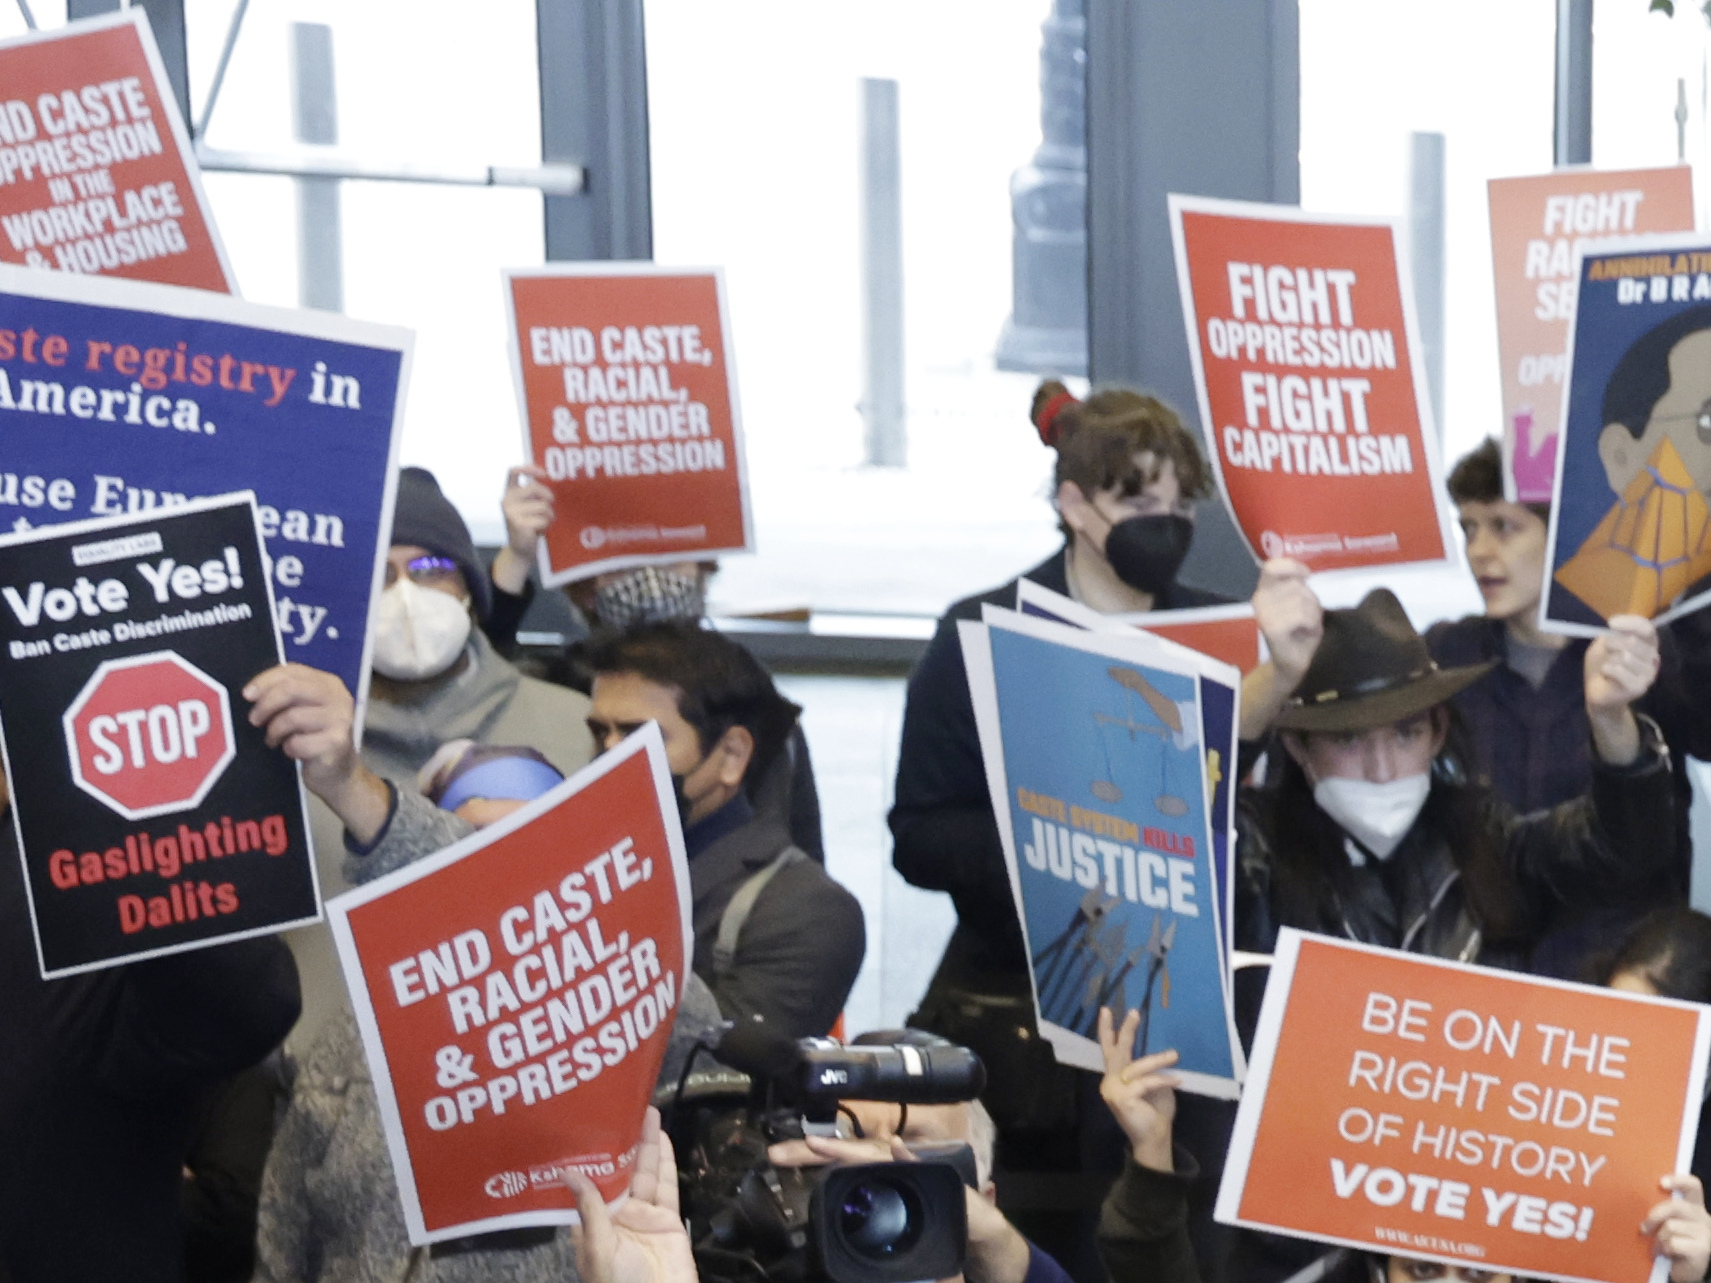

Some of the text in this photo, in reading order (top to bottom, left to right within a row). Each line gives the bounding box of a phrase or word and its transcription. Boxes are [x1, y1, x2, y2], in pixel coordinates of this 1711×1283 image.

[37, 75, 152, 136] CASTE
[0, 118, 163, 185] PPRESSION
[1, 181, 184, 250] WORKPLACE
[48, 168, 117, 204] IN THE
[1543, 189, 1643, 235] FIGHT
[53, 219, 189, 274] HOUSING
[1226, 261, 1356, 326] FIGHT
[1617, 276, 1647, 304] Dr
[1671, 273, 1690, 301] R
[86, 339, 297, 406] registry
[309, 361, 361, 410] in
[529, 325, 713, 367] END CASTE,
[1206, 317, 1397, 370] OPPRESSION
[0, 367, 216, 435] America.
[562, 364, 689, 404] RACIAL,
[1240, 371, 1371, 434] FIGHT
[552, 401, 711, 444] & GENDER
[1222, 426, 1413, 475] CAPITALISM
[544, 438, 726, 481] OPPRESSION
[2, 576, 129, 628] Vote
[136, 546, 244, 603] Yes!
[9, 638, 52, 660] Ban
[53, 625, 111, 653] Caste
[114, 603, 252, 643] Discrimination
[88, 699, 211, 775] STOP
[48, 813, 288, 890] Gaslighting
[1024, 817, 1199, 918] JUSTICE
[117, 880, 240, 934] Dalits
[389, 836, 654, 1008] END CASTE,
[446, 916, 630, 1036] RACIAL,
[435, 937, 661, 1089] & GENDER
[1362, 991, 1631, 1080] BE ON THE
[424, 970, 676, 1132] OPPRESSION
[820, 1068, 848, 1086] JVC
[1348, 1049, 1621, 1137] RIGHT SIDE
[1337, 1106, 1607, 1187] OF HISTORY
[1329, 1156, 1472, 1221] VOTE
[1481, 1187, 1595, 1243] YES!
